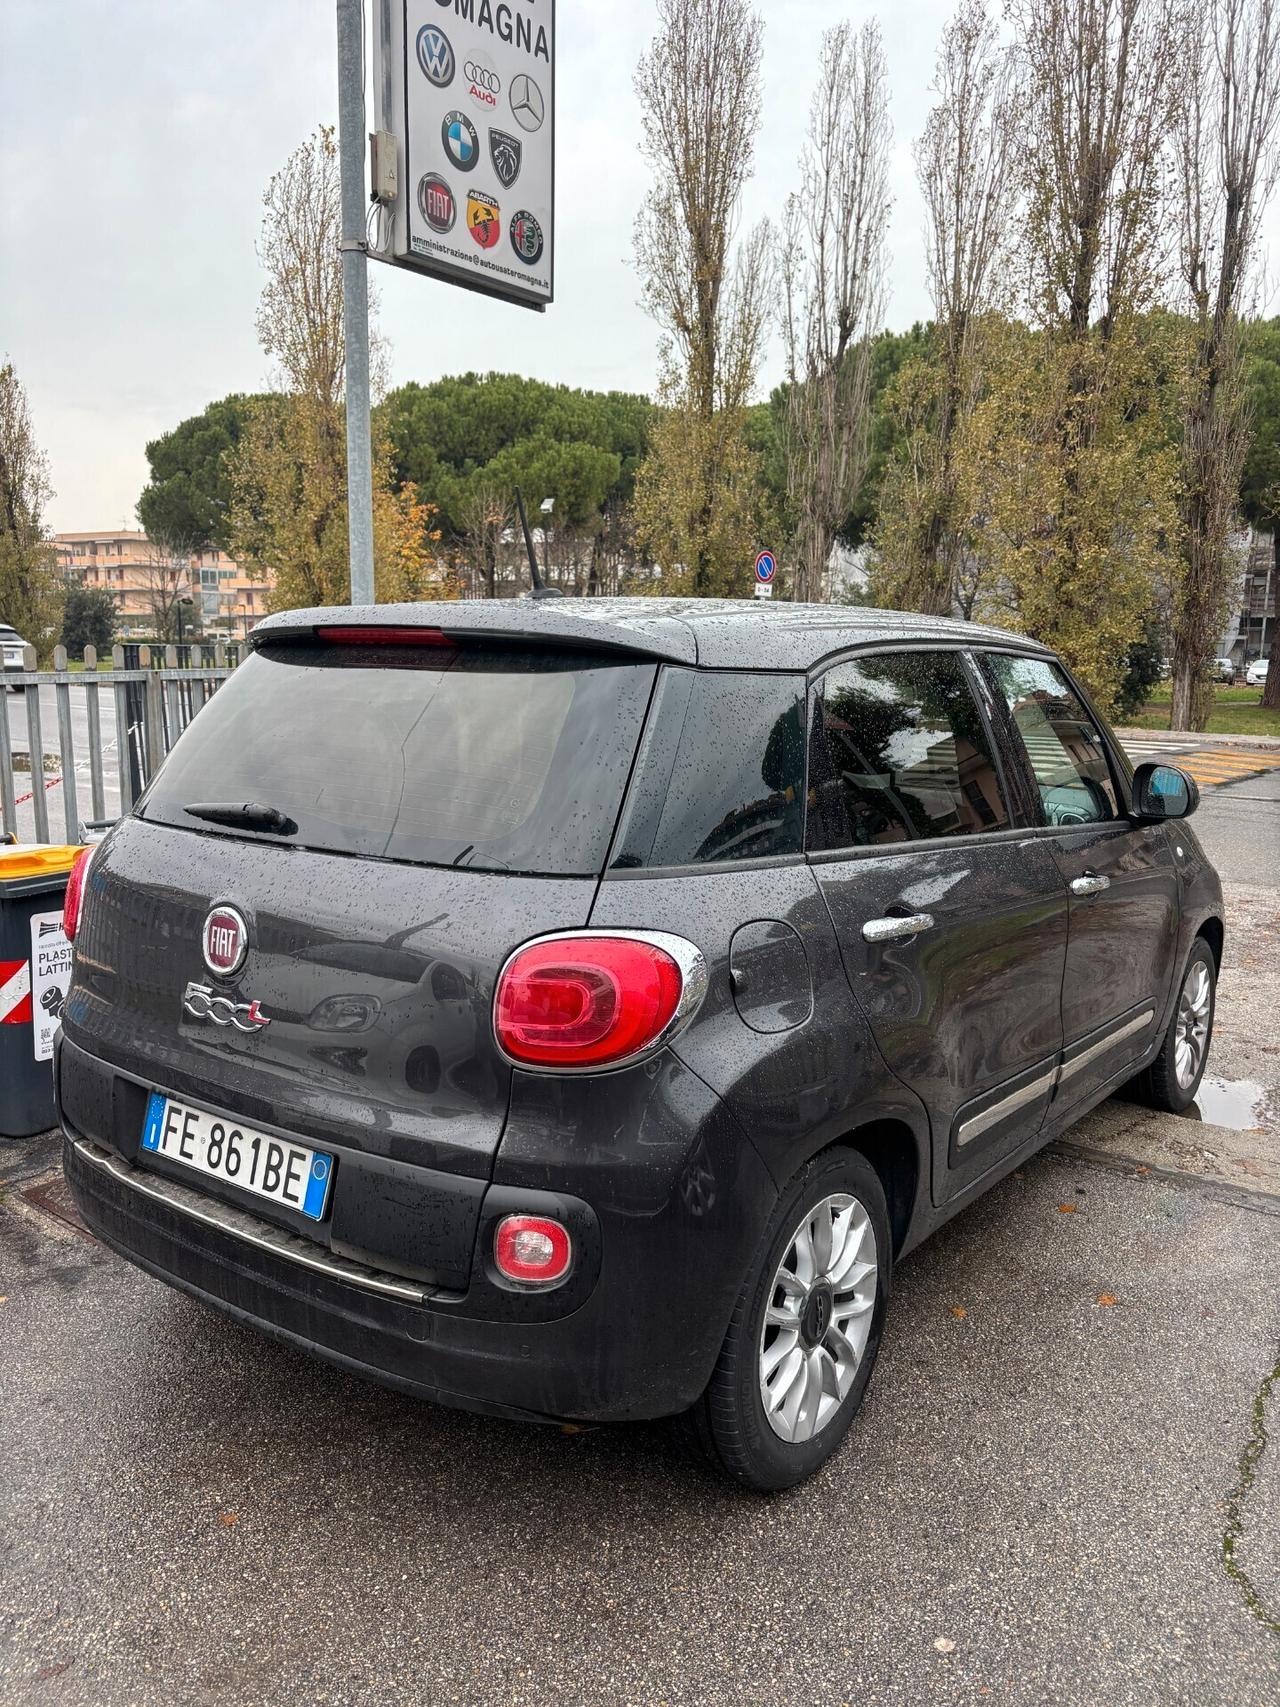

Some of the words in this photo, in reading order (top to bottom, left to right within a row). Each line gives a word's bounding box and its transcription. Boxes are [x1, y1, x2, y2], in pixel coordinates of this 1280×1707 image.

[435, 0, 549, 63] MAGNA
[469, 84, 496, 106] Audi
[444, 112, 478, 137] BMW
[491, 133, 519, 148] PEUGEOT
[427, 188, 449, 220] FIAT
[469, 191, 498, 207] ABARTH
[510, 212, 523, 233] ALFA
[523, 211, 543, 245] ROMEO
[411, 234, 550, 290] amministrazione@autousateromagna.it
[211, 925, 236, 958] FIAT
[162, 1105, 200, 1160] FE
